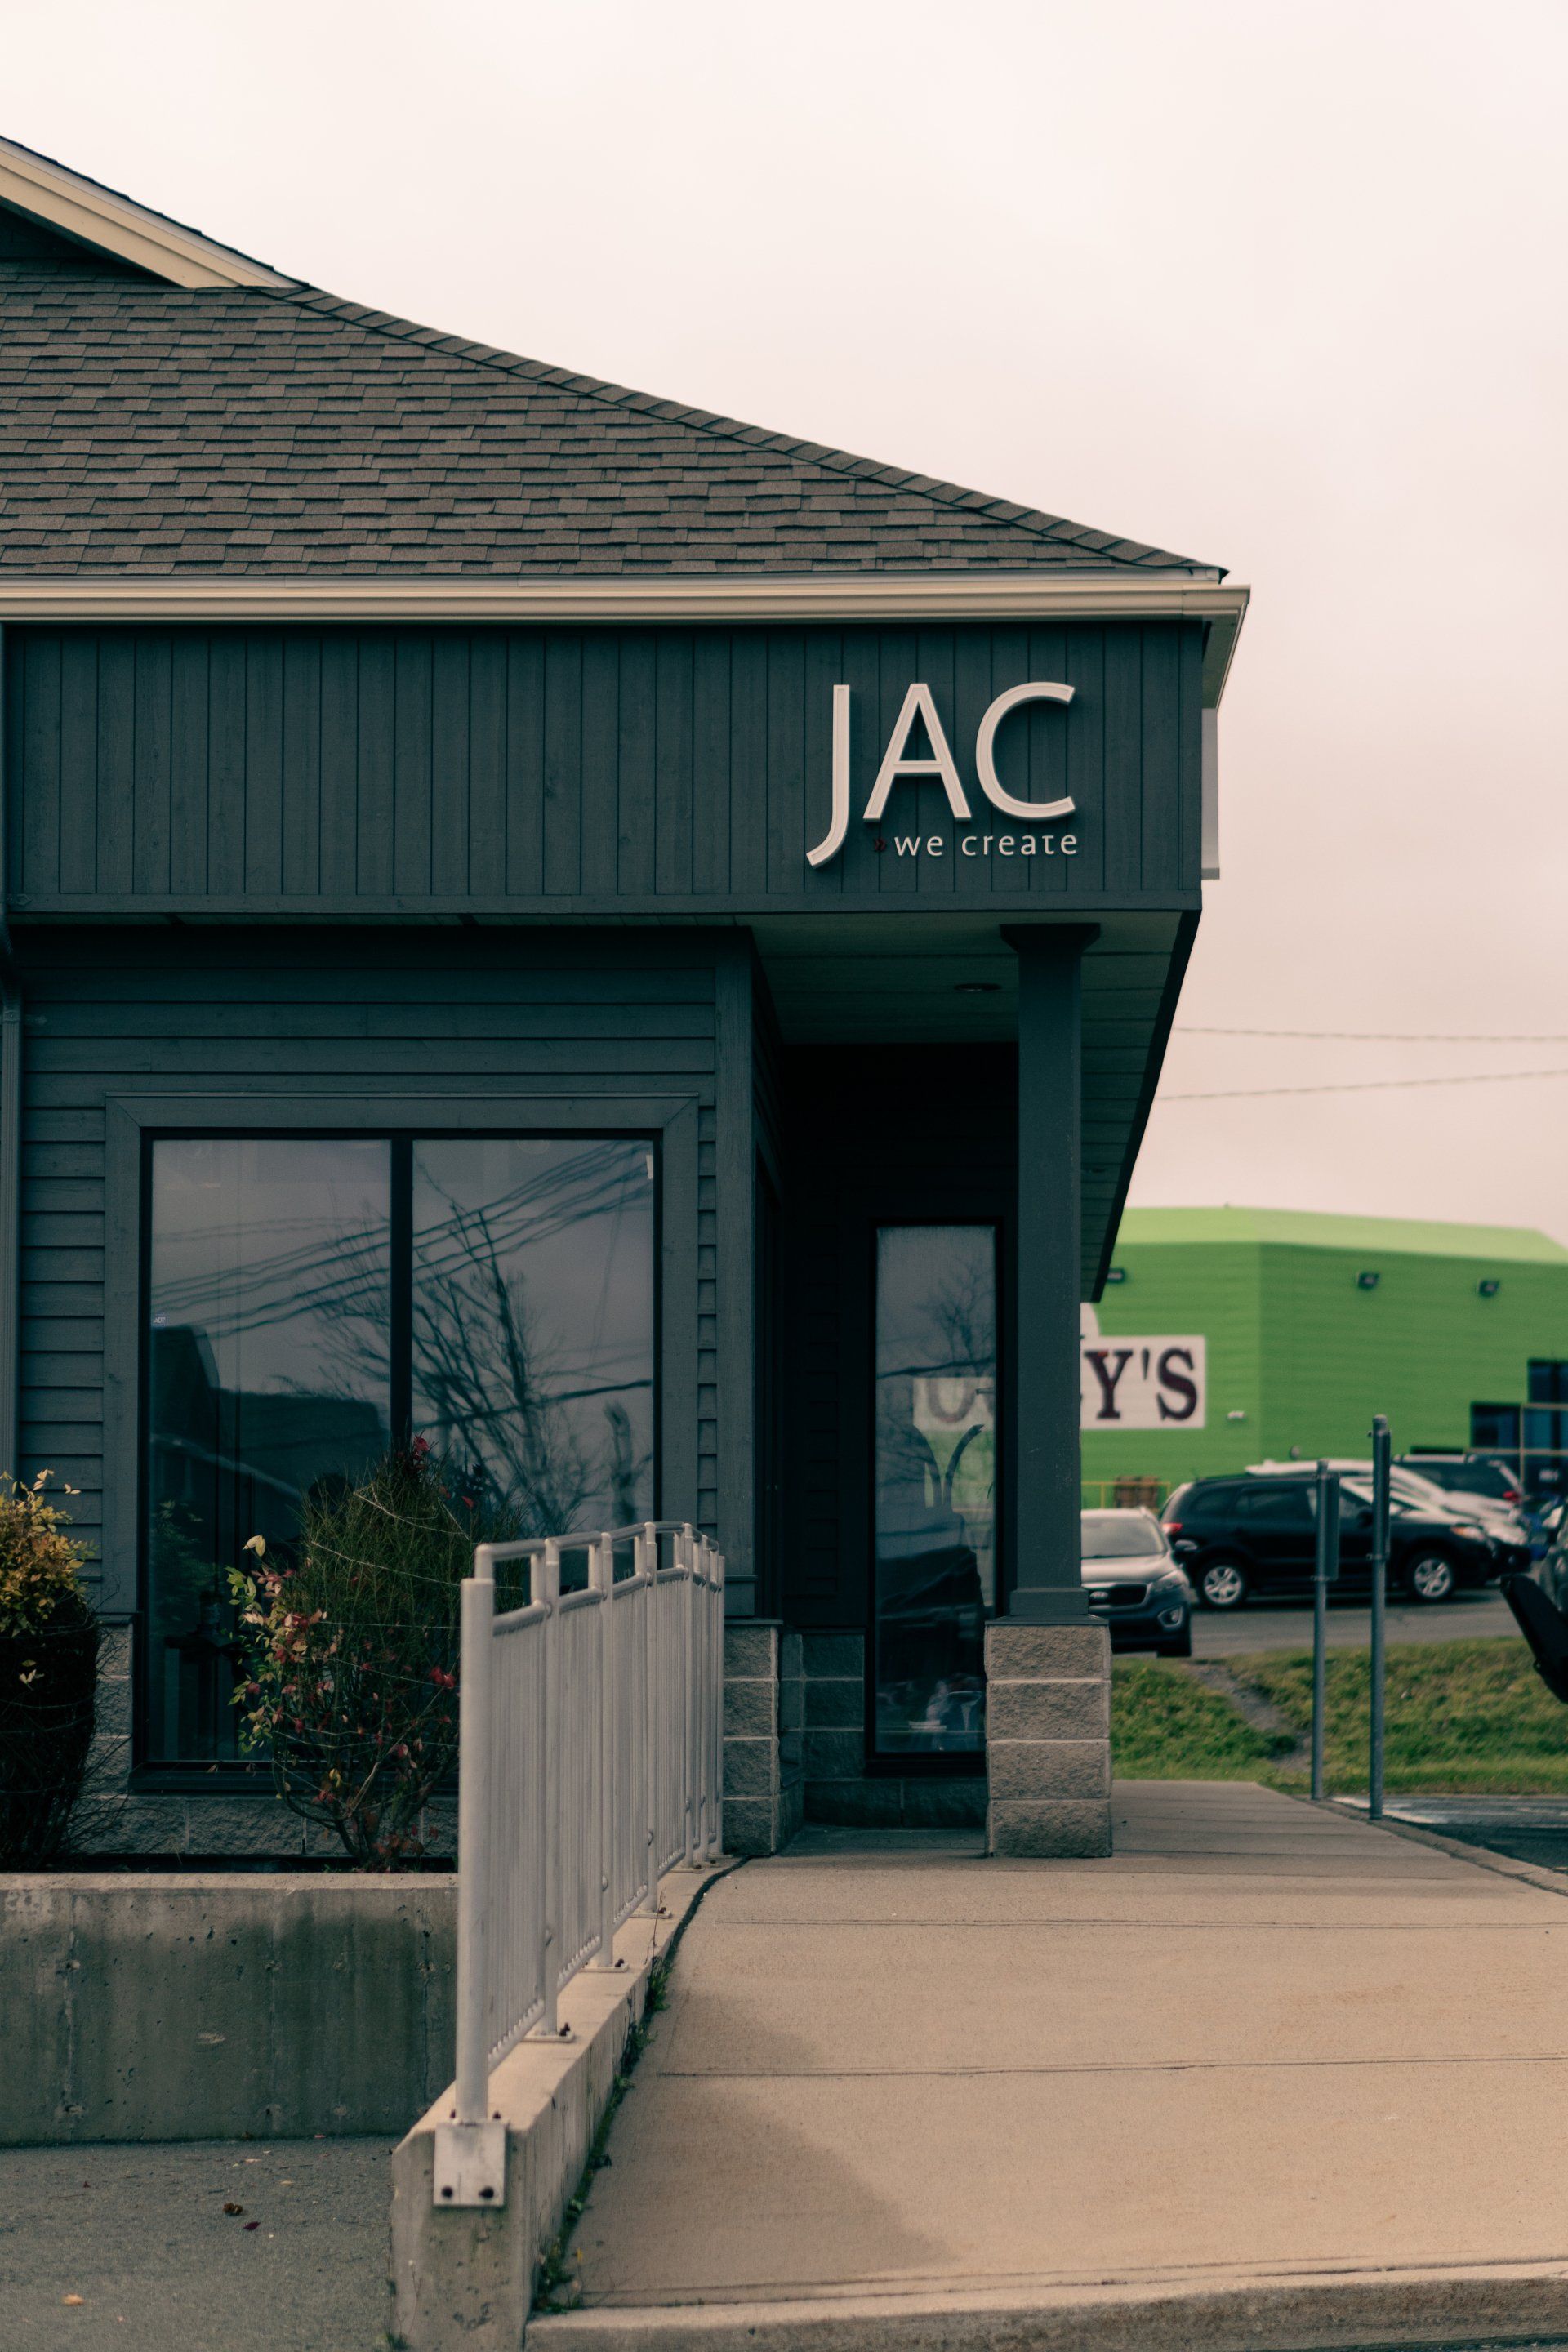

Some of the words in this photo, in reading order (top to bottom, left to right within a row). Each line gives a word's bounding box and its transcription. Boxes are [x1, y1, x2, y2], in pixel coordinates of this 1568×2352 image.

[806, 681, 1076, 867] JAC
[894, 835, 943, 856] we
[961, 834, 1078, 856] create
[1081, 1347, 1198, 1421] Y'S
